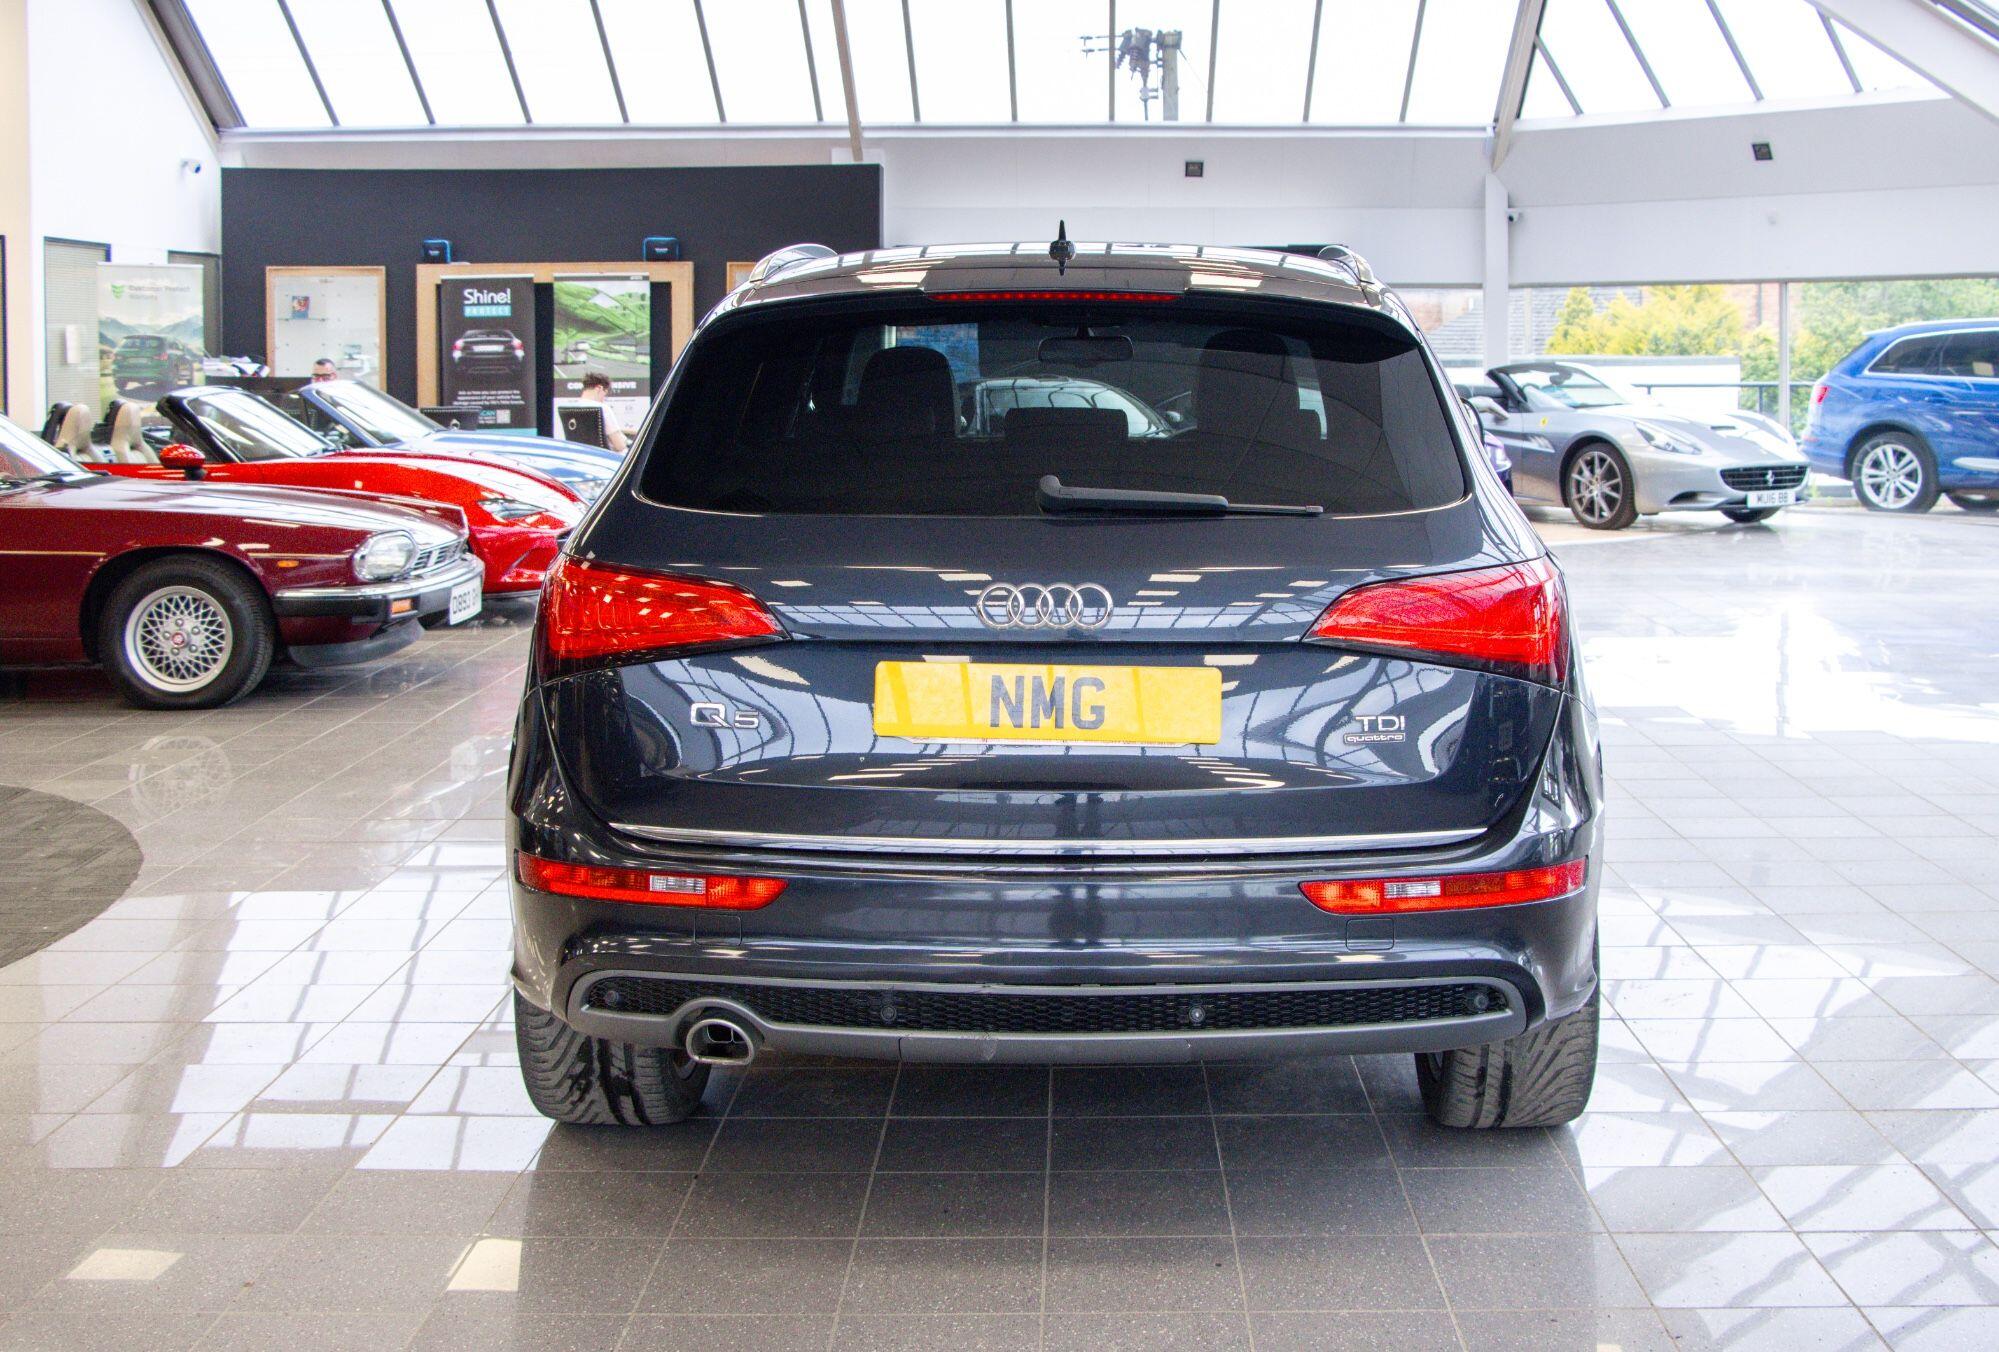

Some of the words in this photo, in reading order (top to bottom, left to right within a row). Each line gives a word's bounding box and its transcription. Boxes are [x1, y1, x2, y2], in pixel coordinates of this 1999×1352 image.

[463, 288, 511, 304] Shine!
[990, 675, 1106, 730] NMG
[690, 703, 759, 729] Q5
[1355, 715, 1406, 732] TDI
[1346, 734, 1404, 743] quattro
